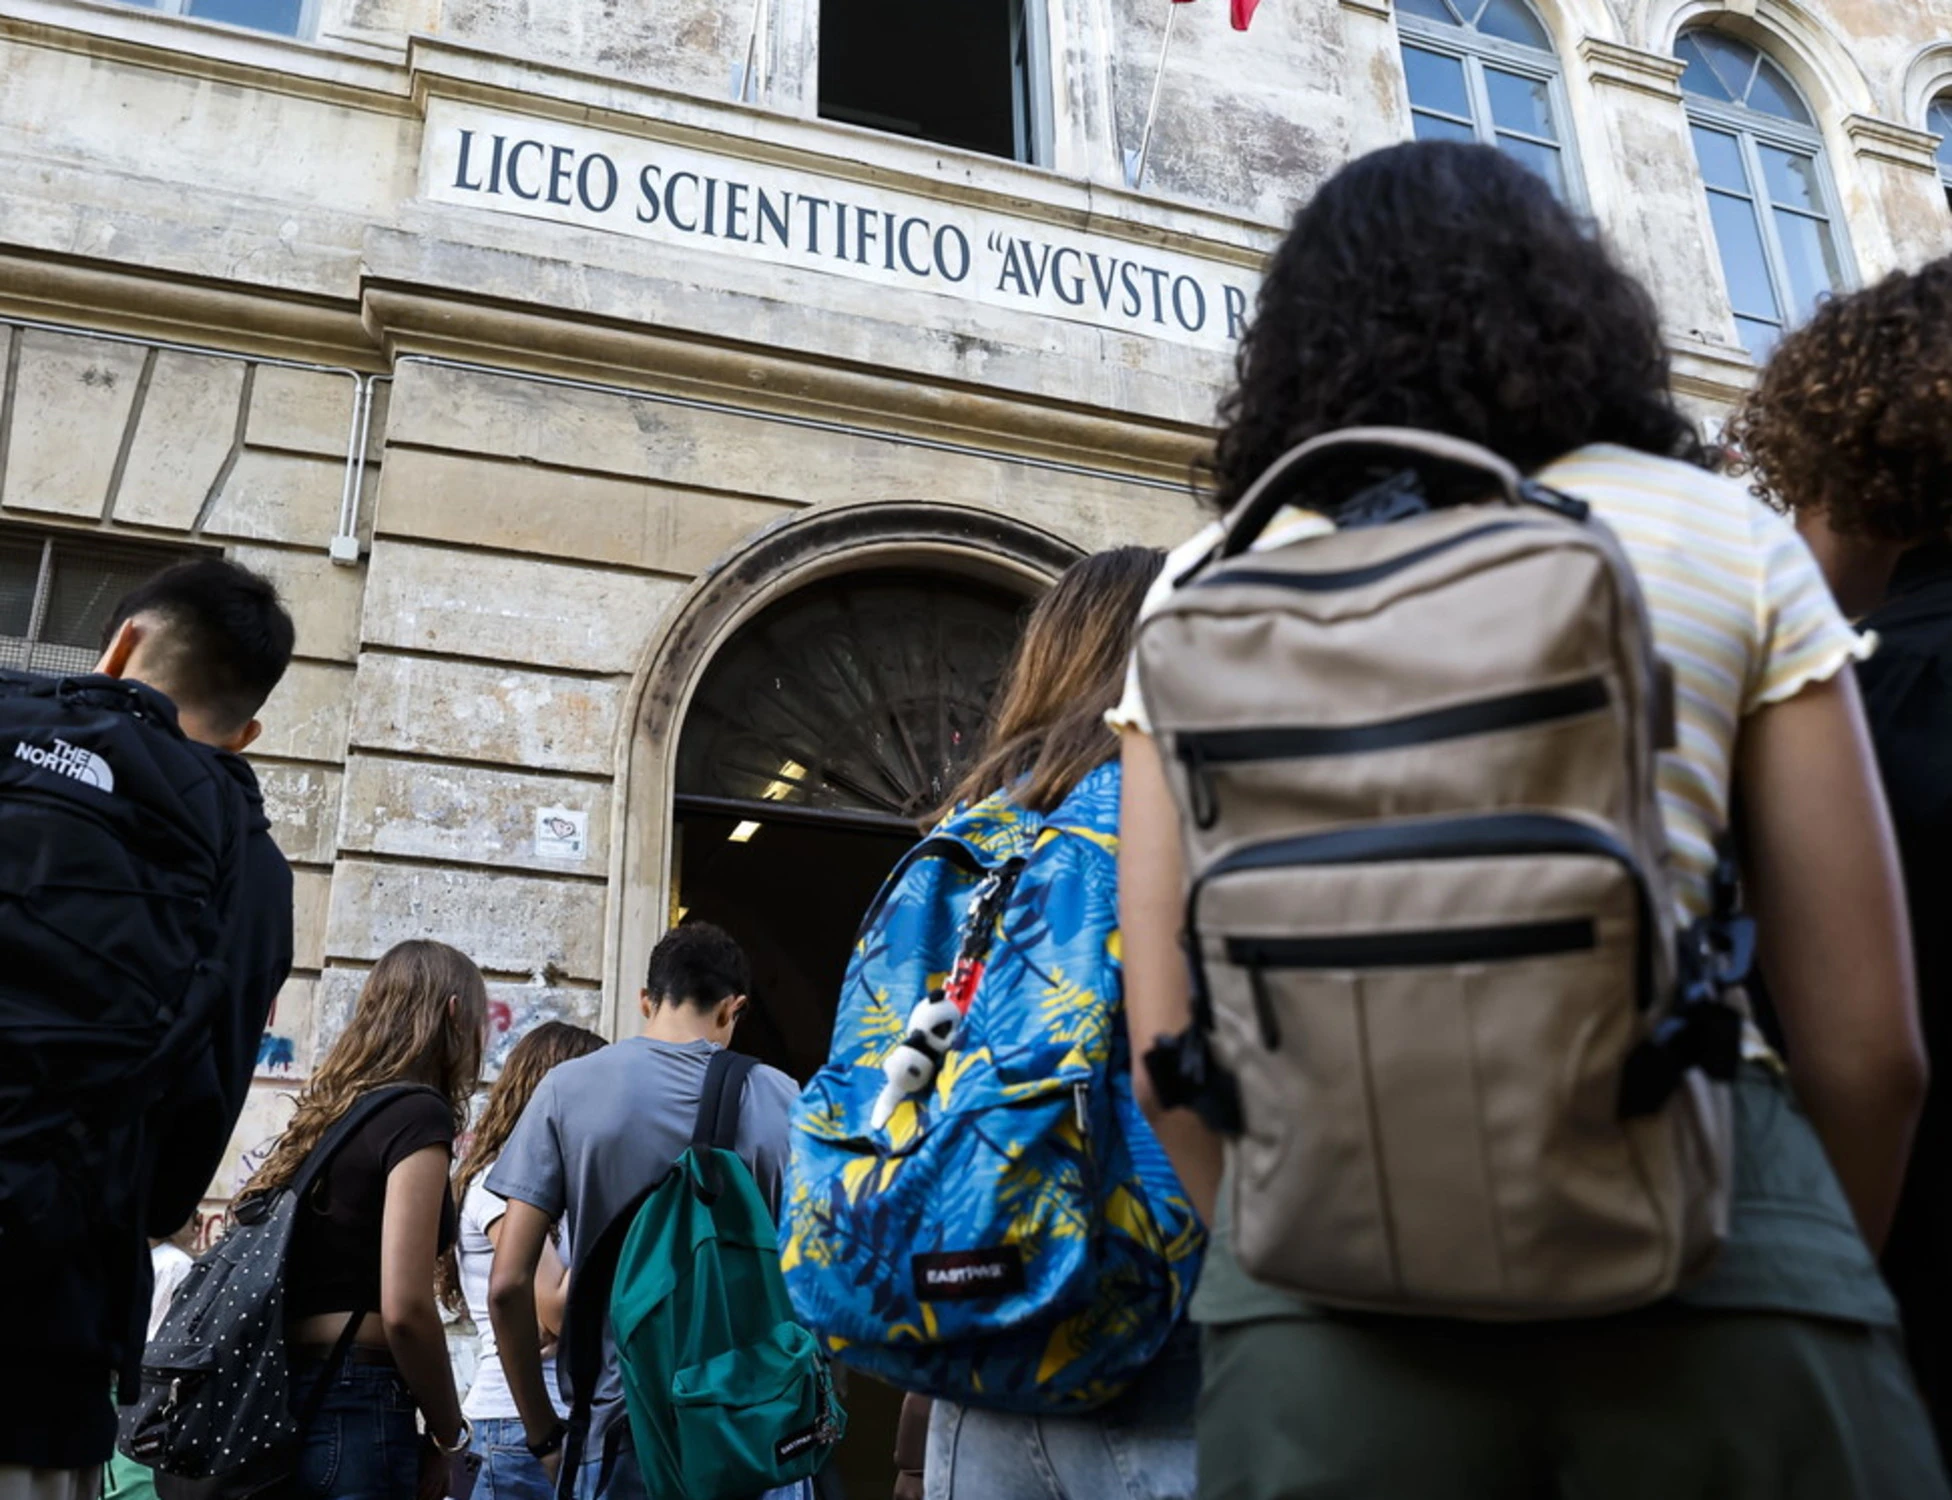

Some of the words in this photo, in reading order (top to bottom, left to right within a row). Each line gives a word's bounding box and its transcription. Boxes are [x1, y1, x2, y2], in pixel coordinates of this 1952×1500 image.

[452, 128, 618, 213] LICEO
[636, 164, 971, 283] SCIENTIFICO
[987, 229, 1207, 333] “AVGVSTO
[14, 741, 84, 780] NORTH
[53, 738, 92, 766] THE
